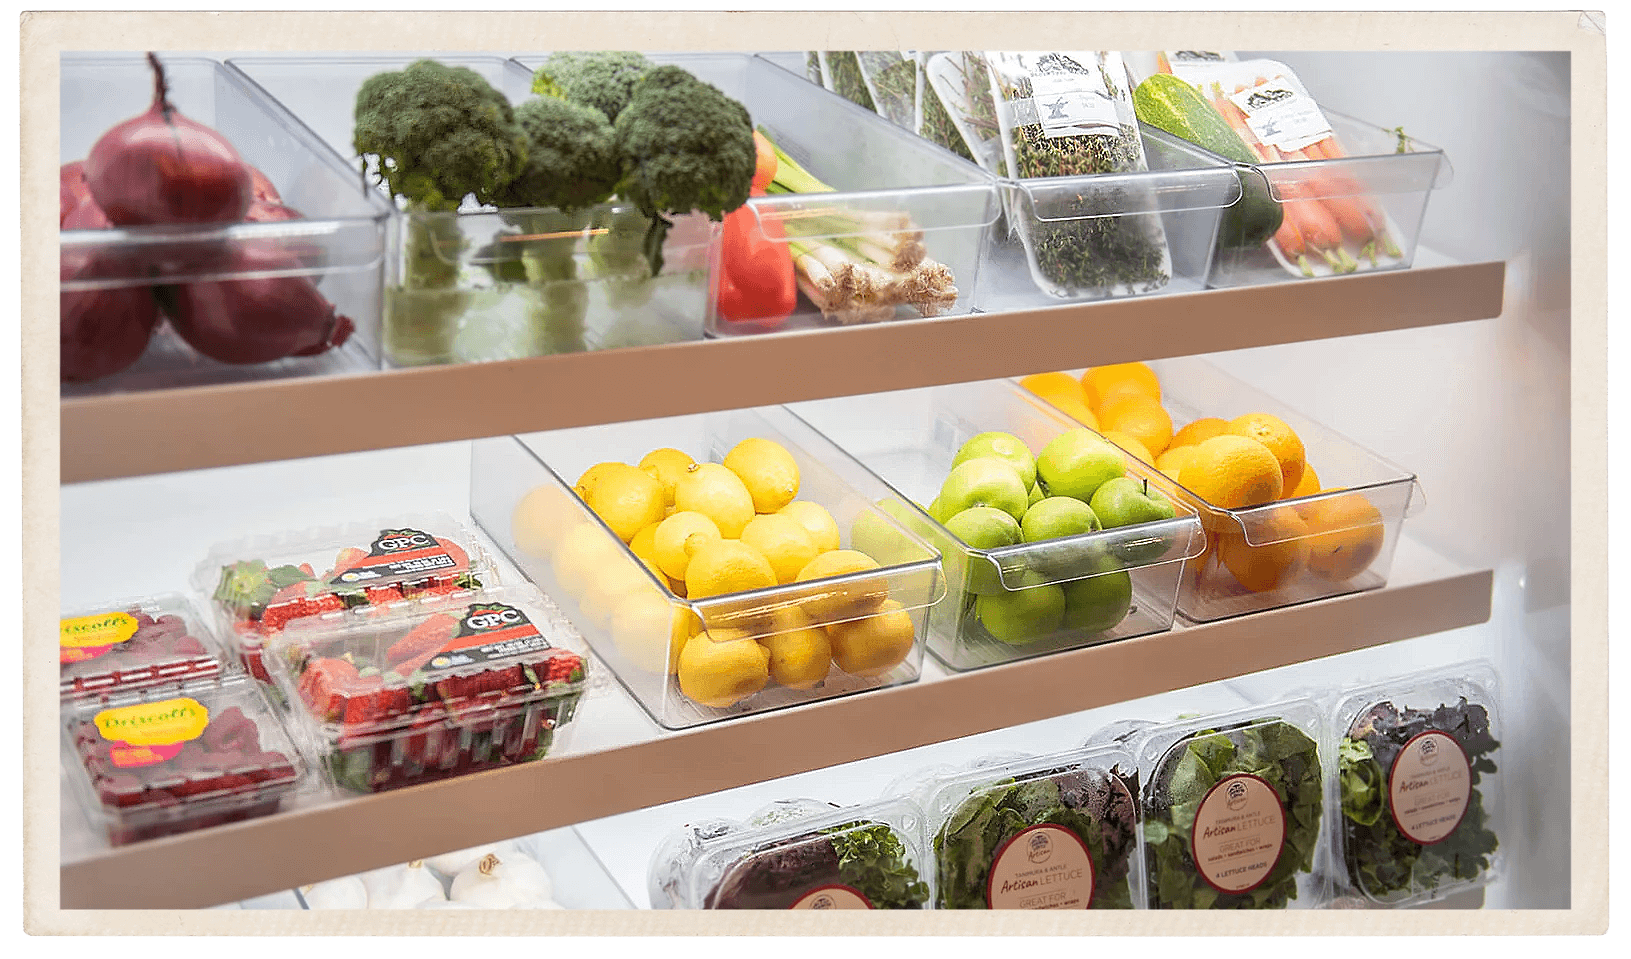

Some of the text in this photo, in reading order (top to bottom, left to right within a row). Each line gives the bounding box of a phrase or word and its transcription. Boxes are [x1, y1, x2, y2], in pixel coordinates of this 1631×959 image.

[378, 534, 429, 550] GPC
[467, 609, 521, 629] GPC
[1399, 780, 1429, 793] Artisan
[1203, 815, 1276, 840] Artisan LETTUCE
[1220, 837, 1261, 853] GREAT FOR
[1028, 850, 1050, 862] Artisan
[1049, 864, 1067, 872] ANTLE
[1221, 866, 1247, 878] LETTUCE
[1248, 861, 1267, 871] HEADS
[1000, 868, 1083, 894] Artisan LETTUCE
[1020, 892, 1067, 909] GREAT FOR
